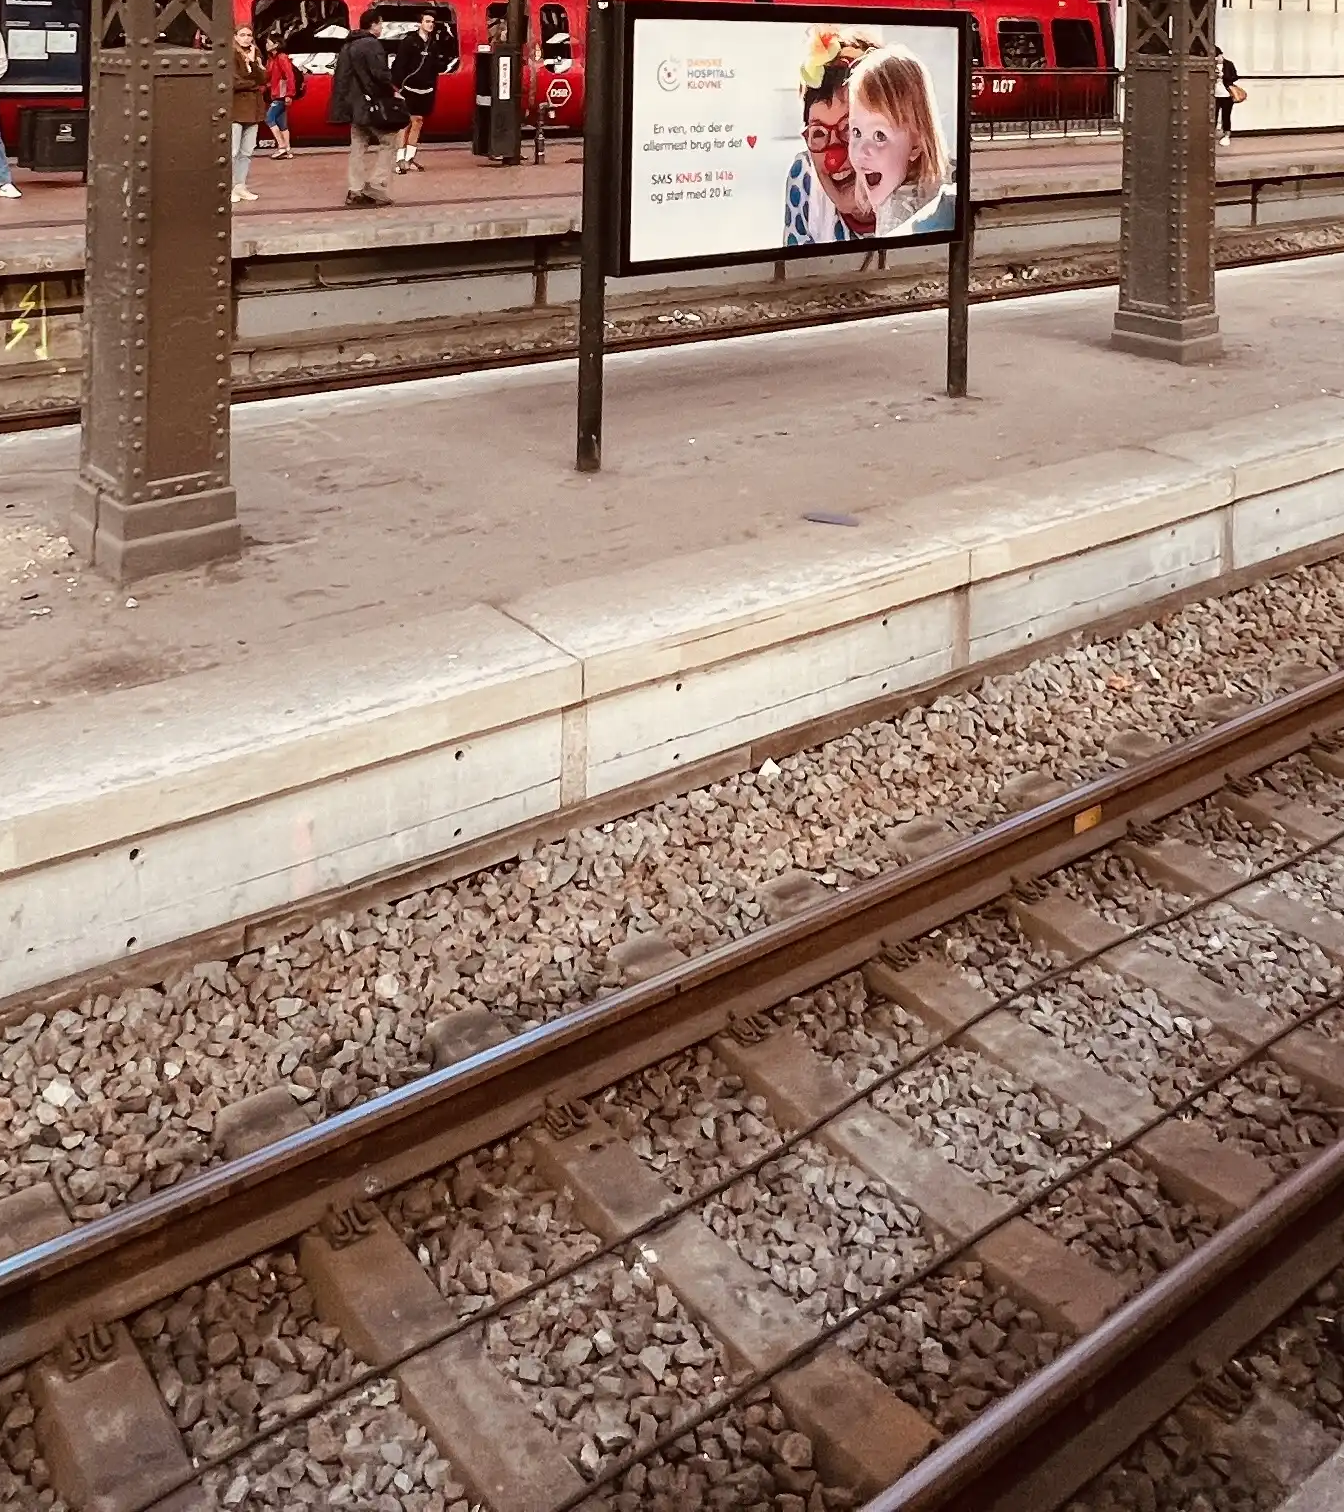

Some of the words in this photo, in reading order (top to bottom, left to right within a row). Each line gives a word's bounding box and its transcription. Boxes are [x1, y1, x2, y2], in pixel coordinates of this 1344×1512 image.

[687, 58, 723, 67] DANSKE
[687, 69, 735, 79] HOSPITALS
[687, 80, 722, 90] KLOVNE
[653, 123, 664, 134] En
[668, 126, 687, 135] ven,
[708, 122, 722, 133] der
[725, 124, 733, 133] er
[643, 140, 687, 151] allermest
[690, 139, 711, 152] brug
[714, 138, 725, 149] for
[728, 137, 743, 148] det
[651, 174, 673, 185] SMS
[675, 172, 702, 184] KNUS
[716, 170, 734, 181] 1416
[650, 192, 663, 204] og
[686, 188, 707, 199] med
[709, 187, 721, 198] 20
